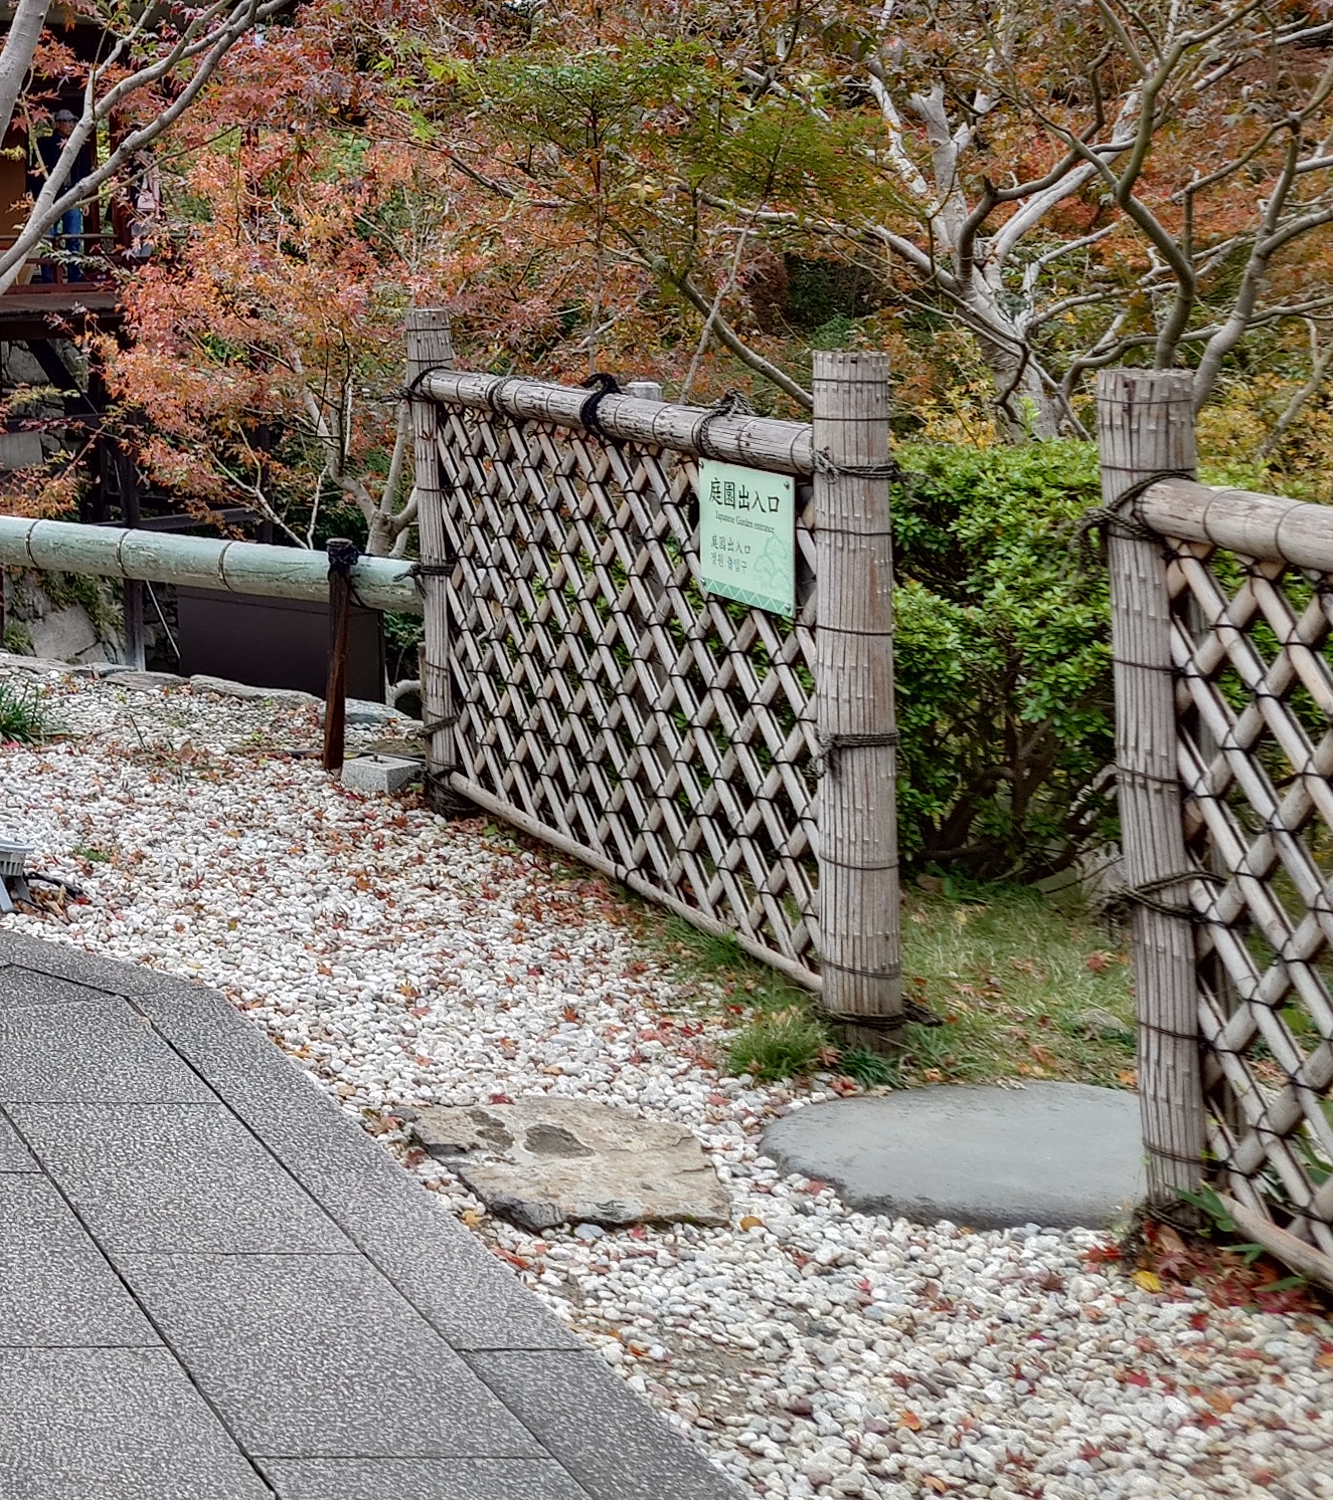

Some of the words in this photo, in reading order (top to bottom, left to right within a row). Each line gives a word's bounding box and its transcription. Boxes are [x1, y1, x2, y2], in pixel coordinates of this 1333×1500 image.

[709, 477, 780, 513] 庭園出入口
